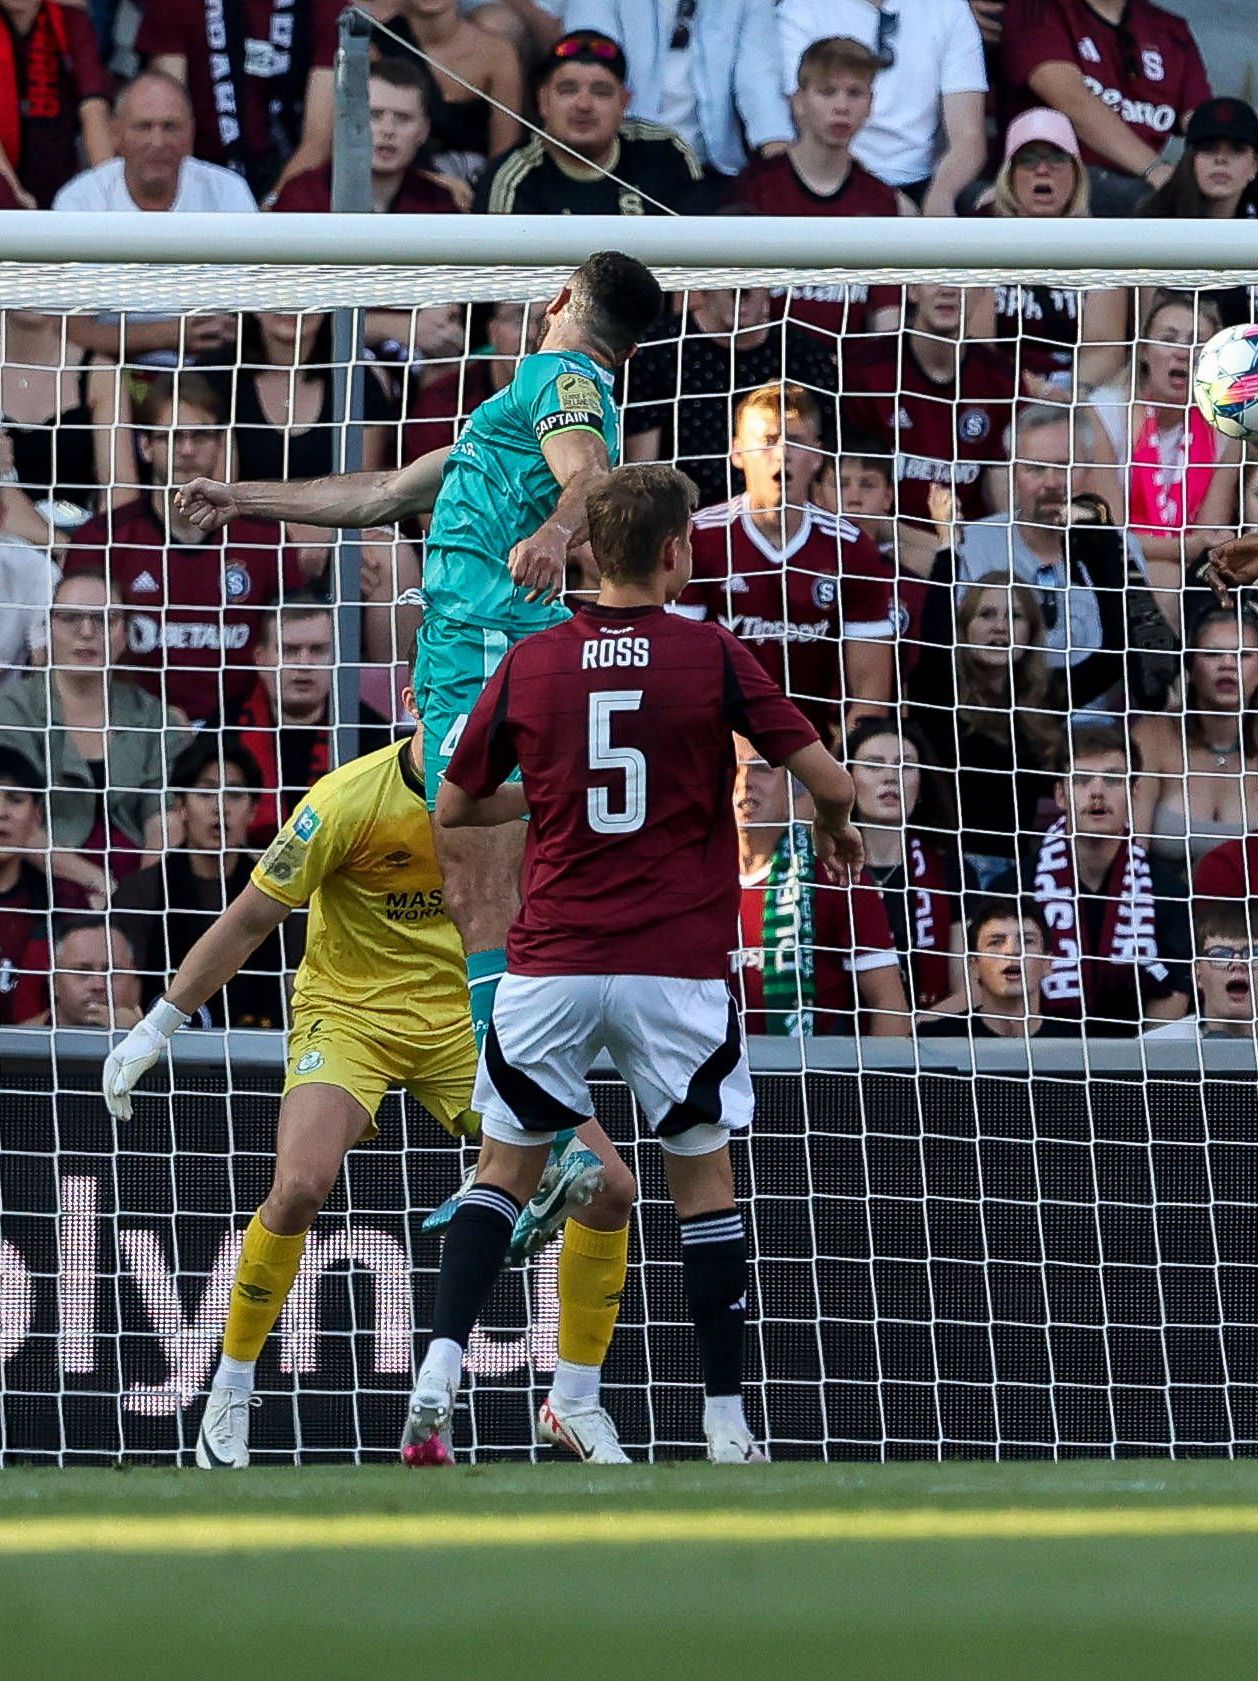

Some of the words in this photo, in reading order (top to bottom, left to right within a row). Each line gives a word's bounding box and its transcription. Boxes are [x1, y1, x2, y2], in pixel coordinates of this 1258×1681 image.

[535, 412, 589, 440] CAPTAIN
[582, 637, 650, 669] ROSS
[587, 690, 646, 834] 5
[386, 889, 443, 908] MAS
[386, 907, 445, 920] WORK
